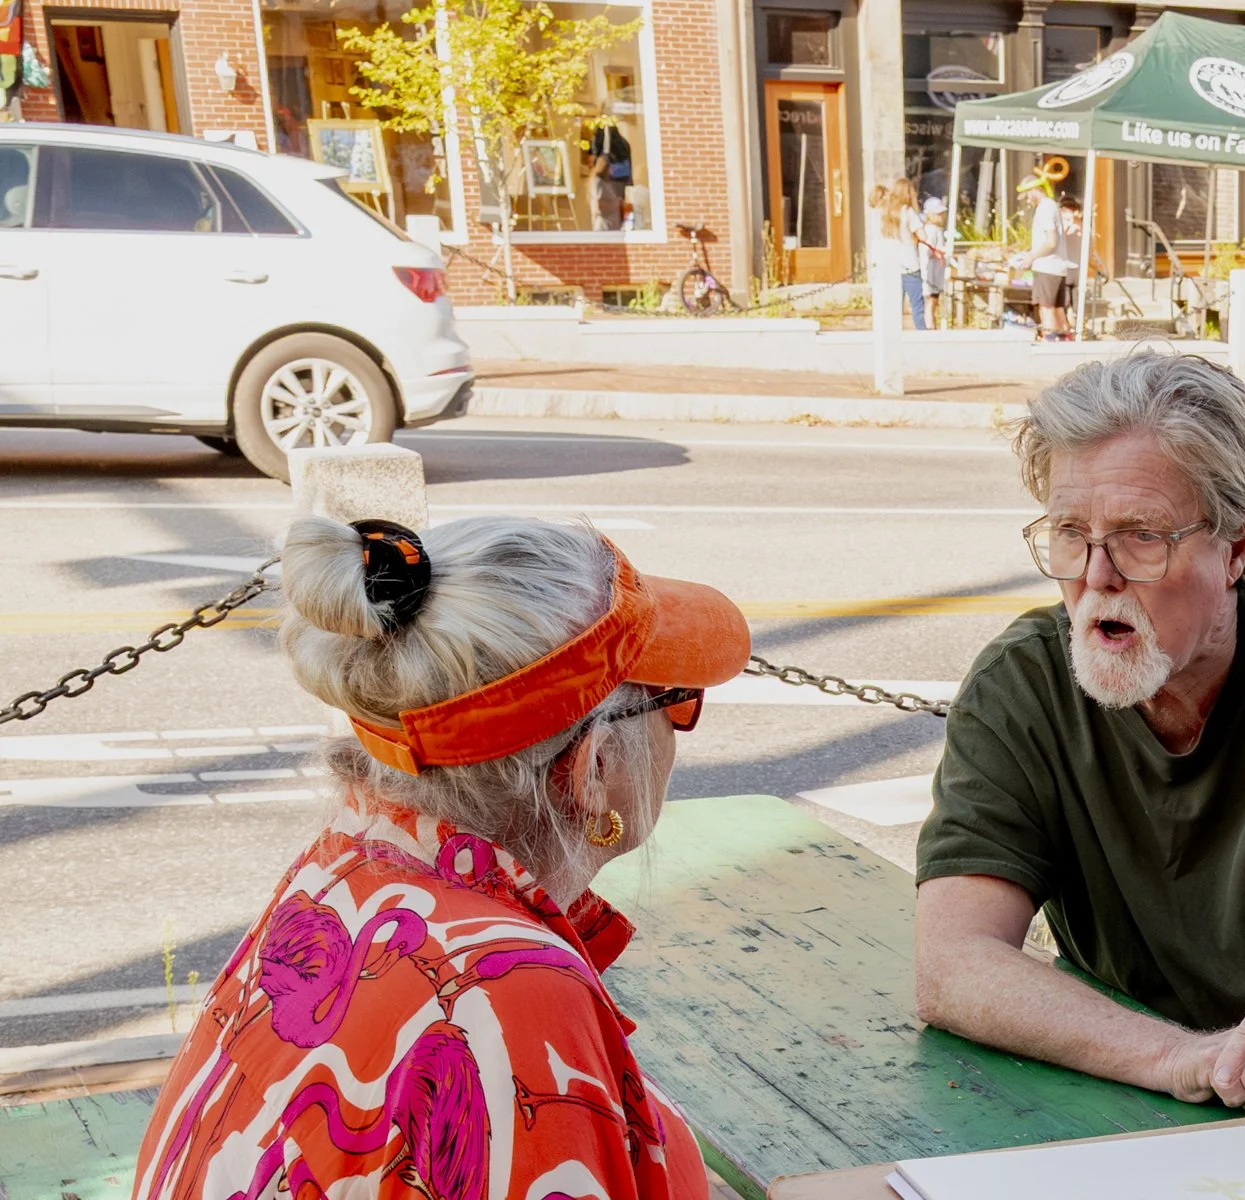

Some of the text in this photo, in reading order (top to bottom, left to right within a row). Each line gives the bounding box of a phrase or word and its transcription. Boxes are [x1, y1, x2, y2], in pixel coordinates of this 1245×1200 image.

[1122, 120, 1163, 144] Like
[1168, 128, 1191, 148] us
[1195, 132, 1221, 151] on
